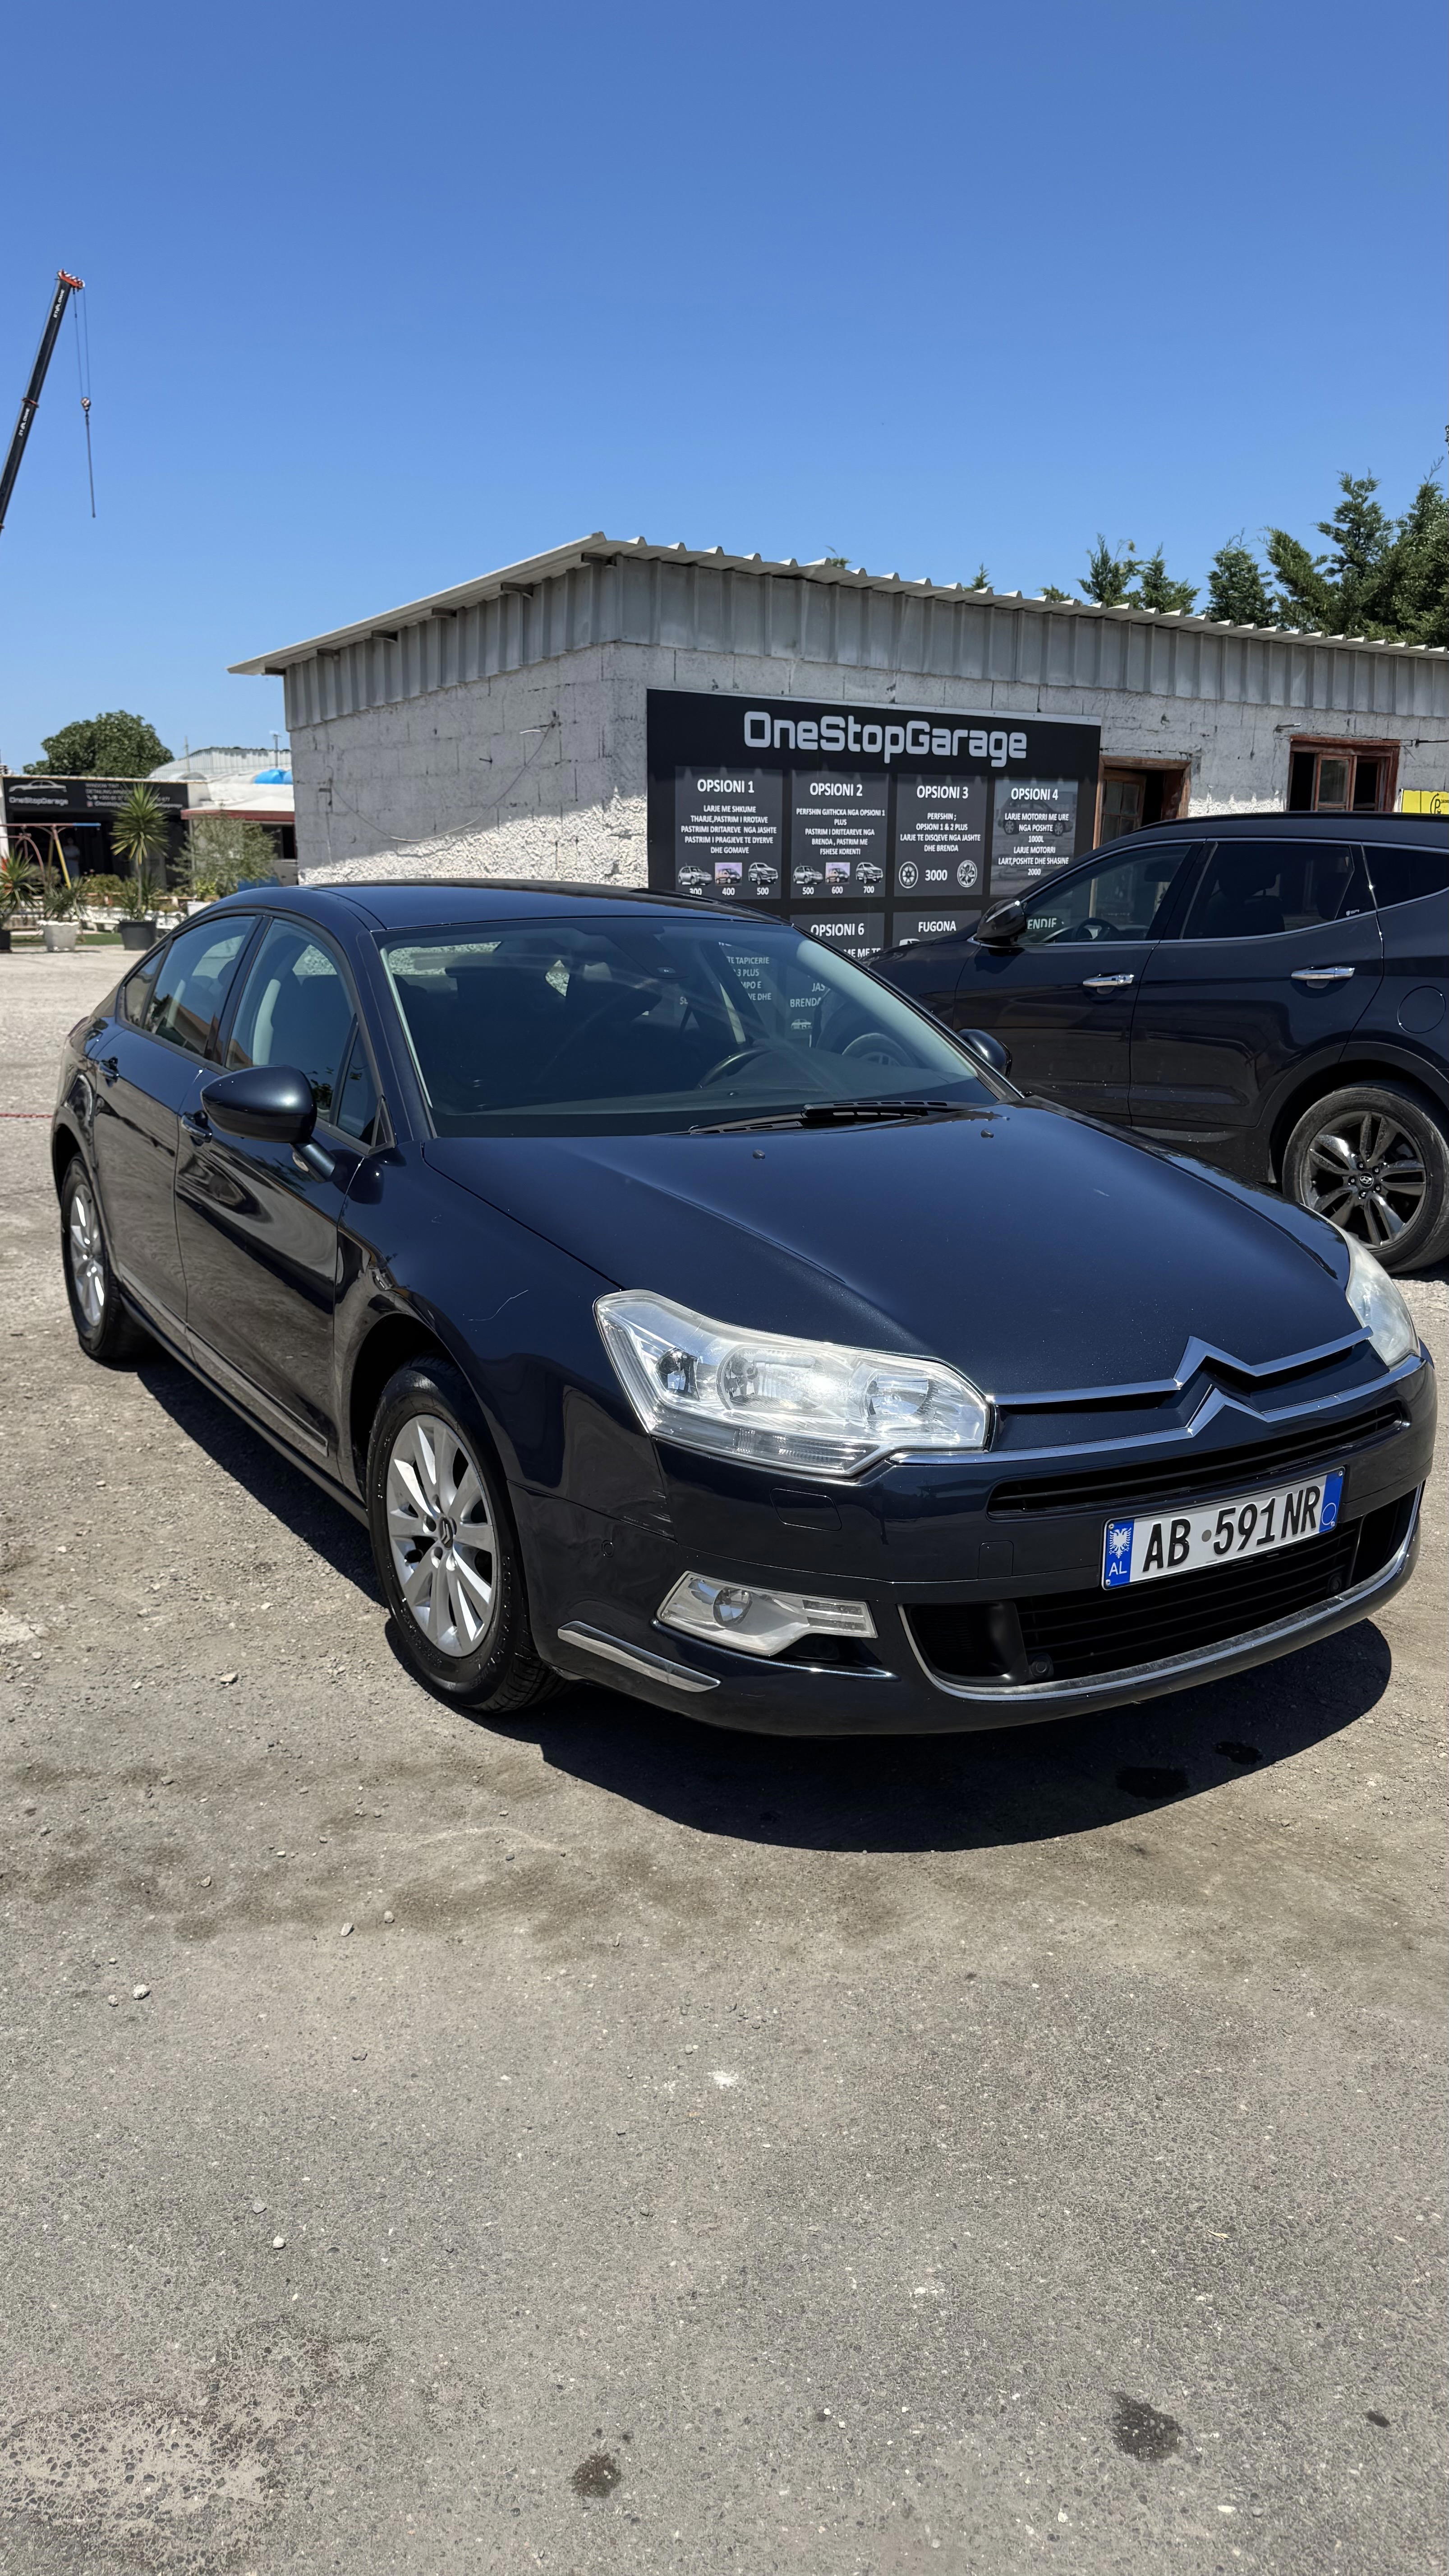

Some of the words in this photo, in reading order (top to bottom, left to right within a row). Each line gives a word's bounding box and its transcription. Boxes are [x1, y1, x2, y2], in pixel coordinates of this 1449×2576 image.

[744, 711, 1027, 767] OneStopGarage
[697, 779, 745, 793] OPSIONI
[748, 781, 754, 793] 1
[810, 783, 854, 796] OPSIONI
[856, 784, 863, 796] 2
[917, 786, 960, 799] OPSIONI
[962, 787, 968, 799] 3
[1011, 788, 1050, 800] OPSIONI
[1052, 789, 1058, 800] 4
[925, 869, 947, 881] 3000
[810, 924, 855, 936] OPSIONI
[858, 923, 865, 935] 6
[918, 920, 956, 932] FUGONA
[743, 969, 759, 977] PLUS
[1142, 1518, 1191, 1573] AB
[1109, 1561, 1127, 1577] AL
